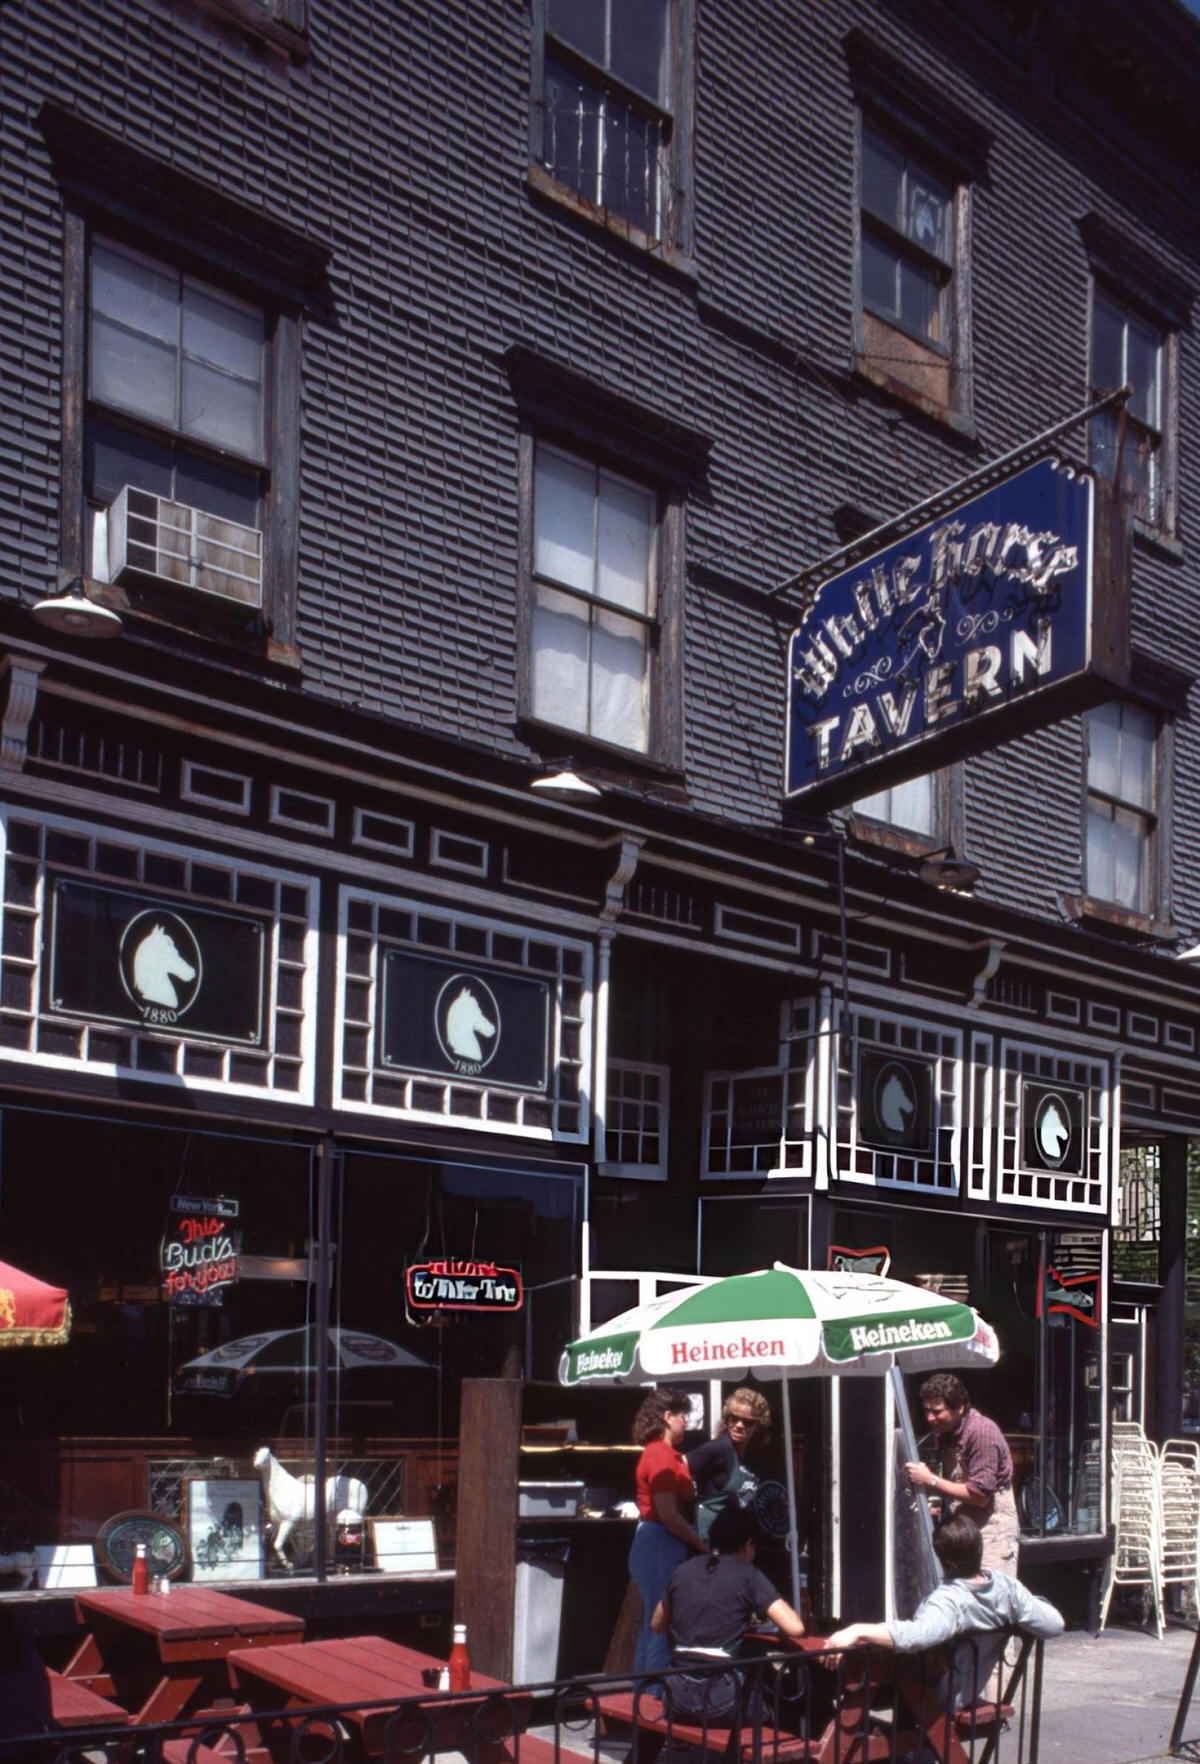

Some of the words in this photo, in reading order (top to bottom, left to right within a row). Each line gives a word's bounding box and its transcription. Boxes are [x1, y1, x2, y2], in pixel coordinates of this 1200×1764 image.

[793, 553, 923, 698] White
[927, 519, 1079, 596] Horse
[804, 617, 1053, 771] TAVERN
[143, 1006, 179, 1024] 1880
[454, 1060, 482, 1075] 1880
[179, 1216, 225, 1243] This
[164, 1236, 238, 1270] Bud's
[165, 1269, 196, 1296] for
[849, 1319, 953, 1351] Heineken
[670, 1338, 786, 1365] Heineken
